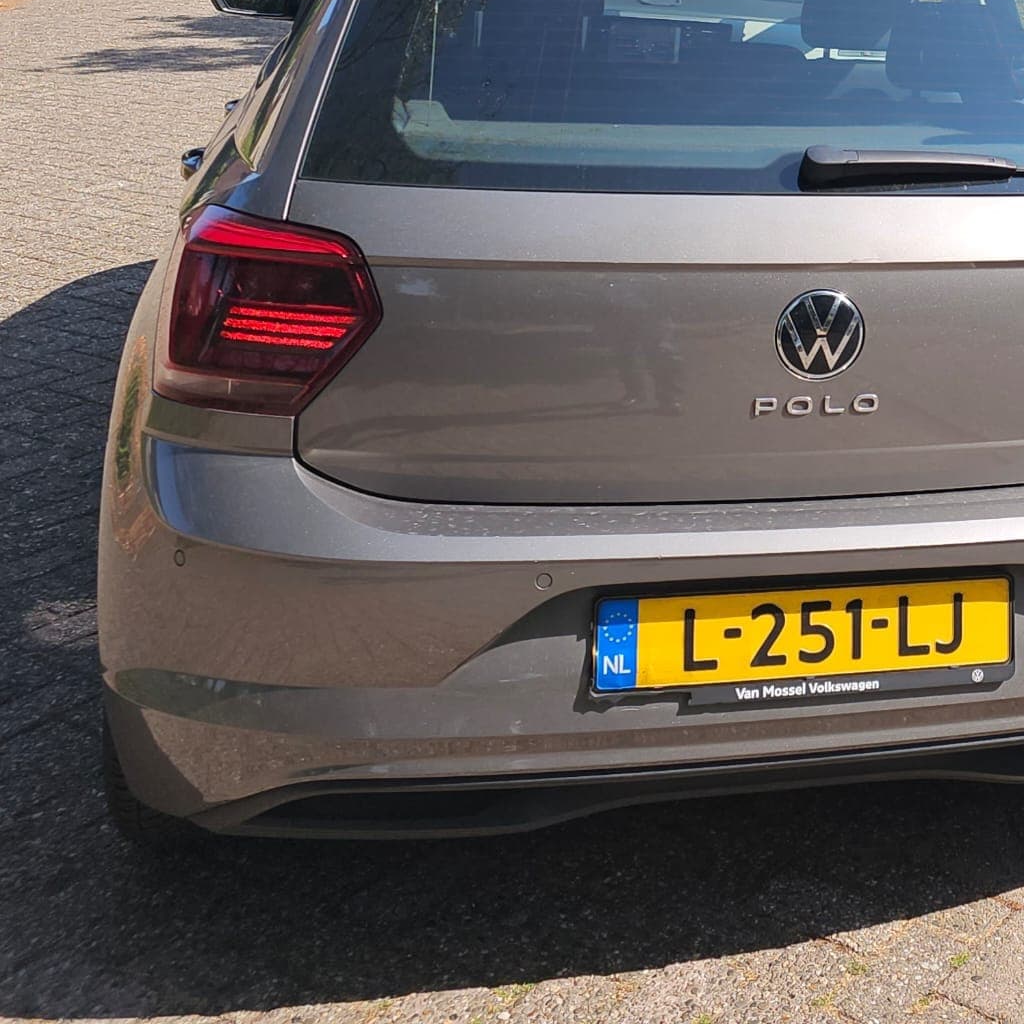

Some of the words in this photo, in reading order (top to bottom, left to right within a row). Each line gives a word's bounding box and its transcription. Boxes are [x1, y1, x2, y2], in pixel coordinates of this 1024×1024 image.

[754, 392, 880, 417] POLO
[684, 592, 964, 672] L-251-LJ
[602, 655, 632, 676] NL
[735, 686, 759, 700] Van
[762, 683, 807, 698] Mossel
[809, 679, 880, 696] Volkswagen
